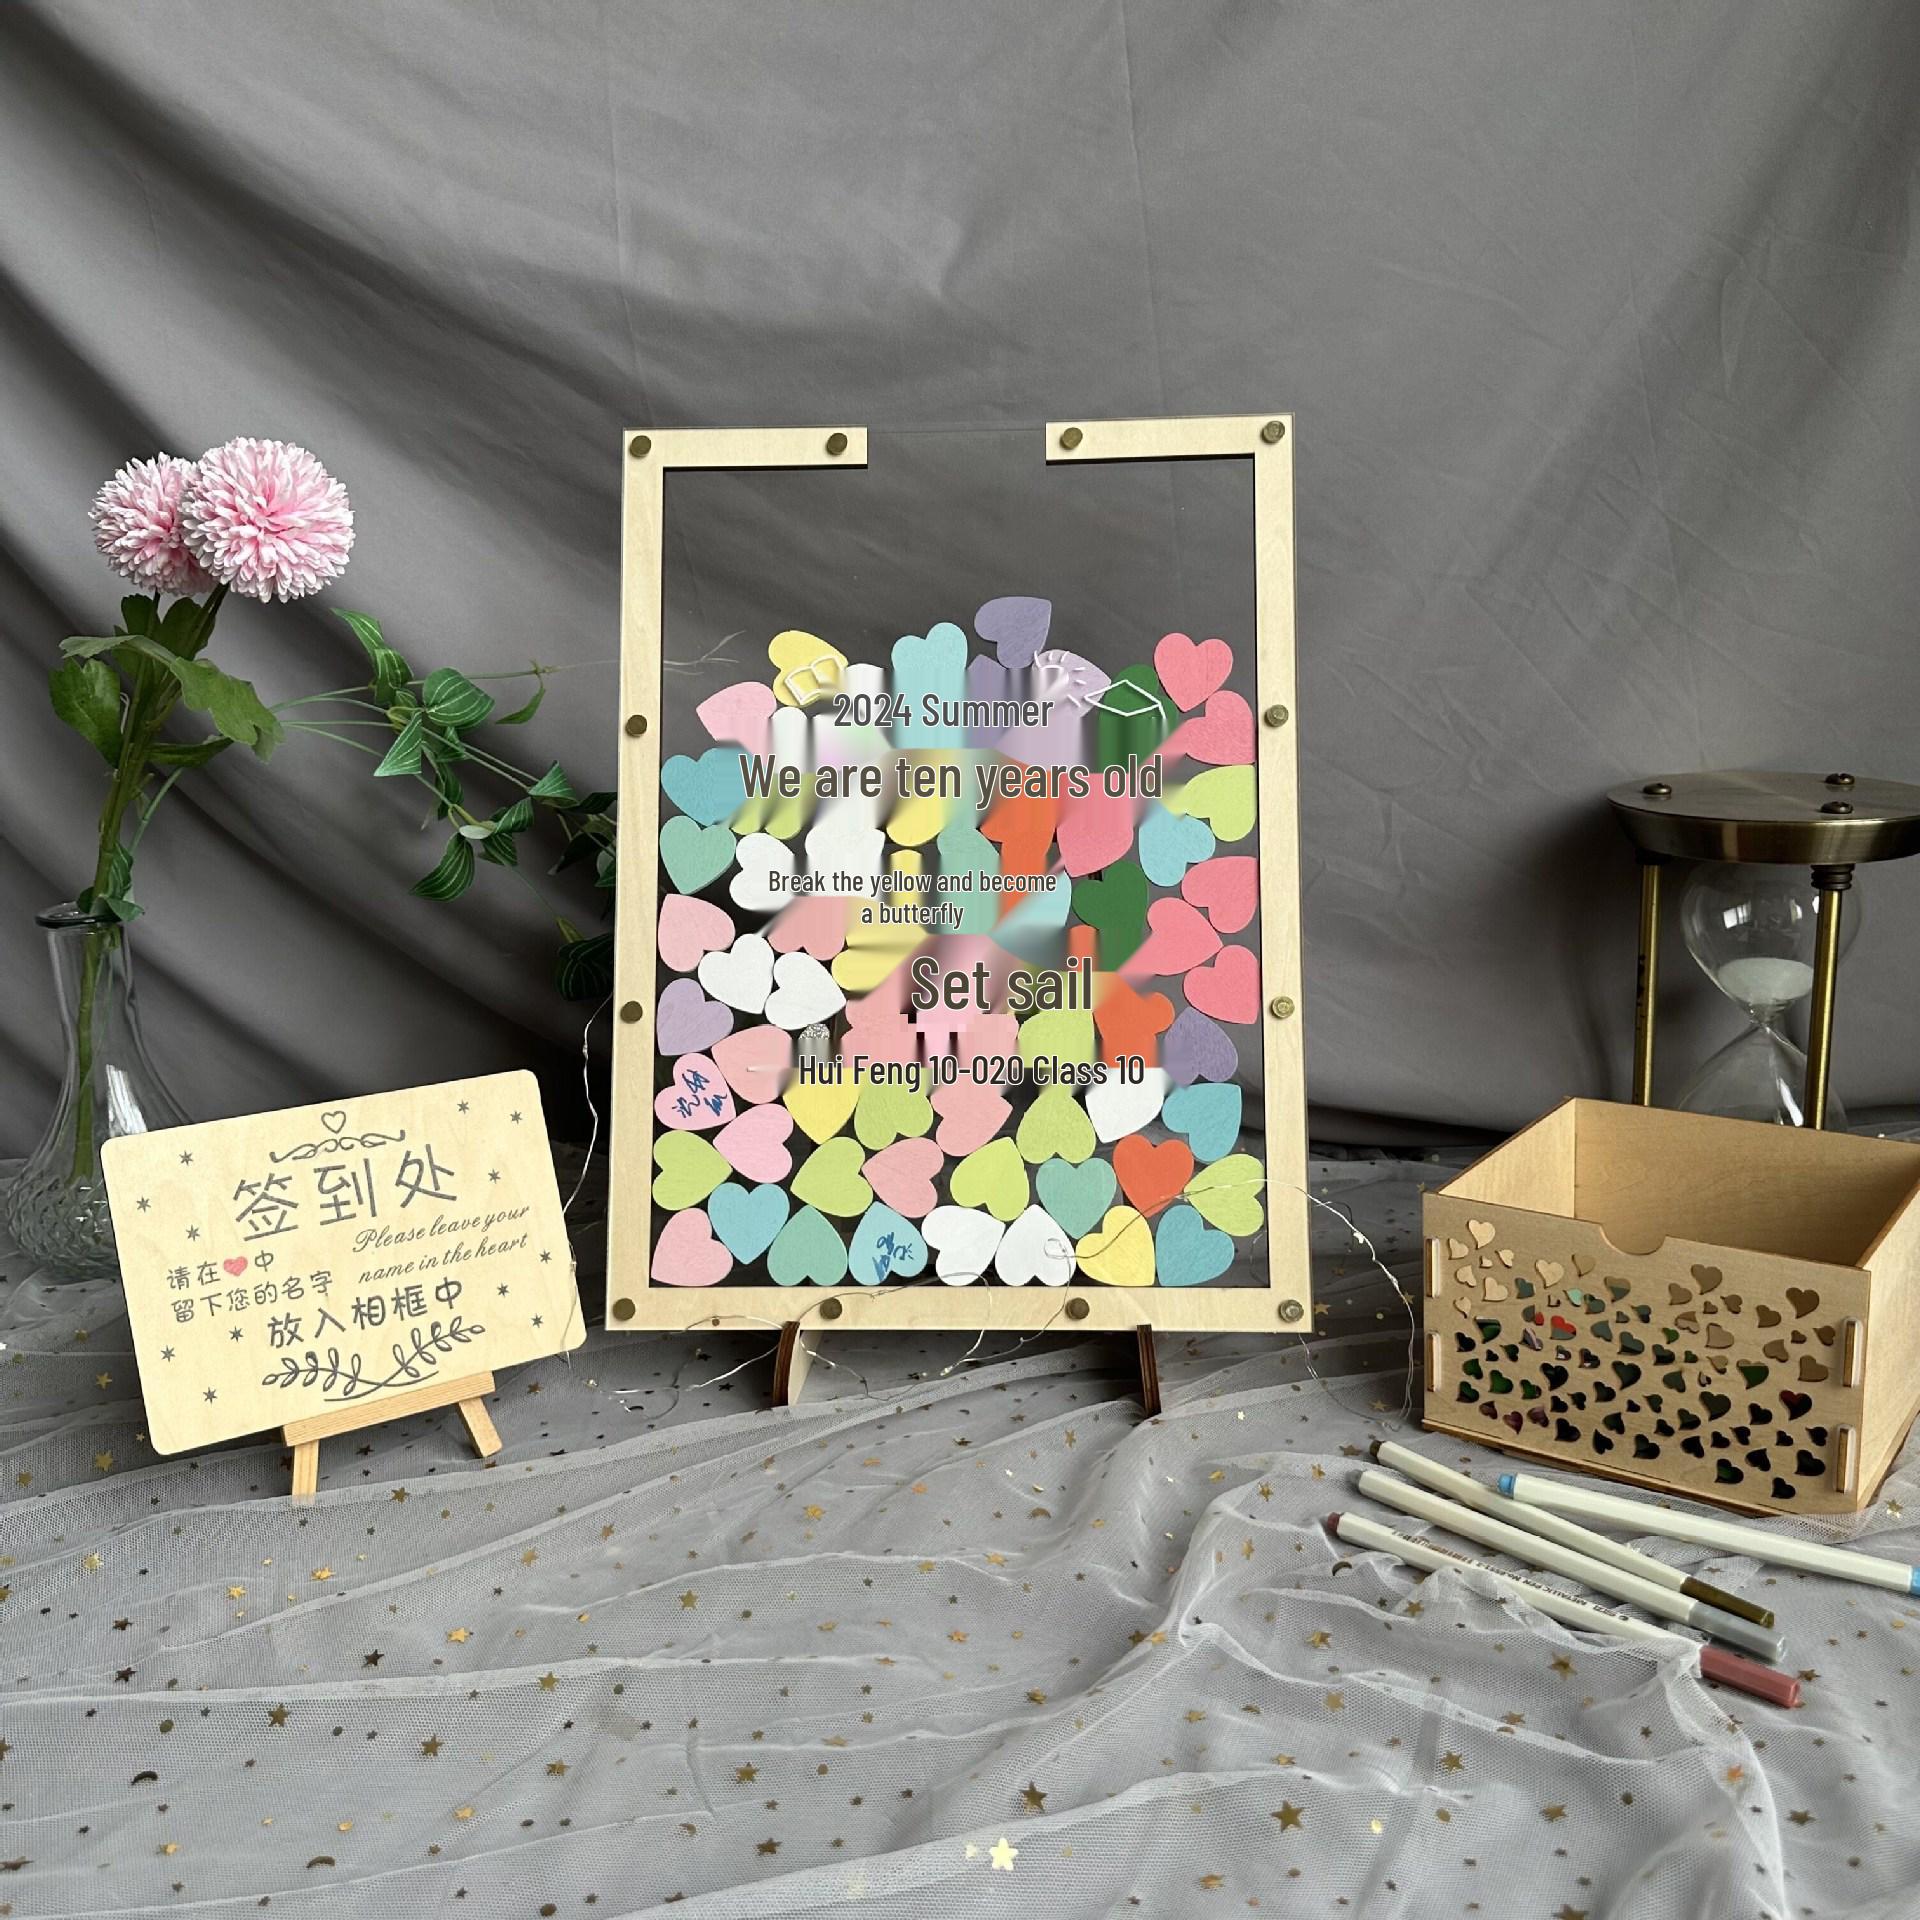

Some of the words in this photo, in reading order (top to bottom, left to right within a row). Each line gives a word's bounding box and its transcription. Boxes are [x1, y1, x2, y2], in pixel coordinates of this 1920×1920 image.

[233, 1143, 458, 1241] 签到处
[352, 1225, 426, 1253] Please
[429, 1214, 481, 1237] leave
[481, 1205, 530, 1233] your
[359, 1261, 415, 1284] name
[418, 1254, 439, 1271] in
[442, 1242, 472, 1266] the
[475, 1233, 528, 1258] heart
[171, 1270, 333, 1324] 留下您的名字
[268, 1276, 462, 1348] 放入相框中
